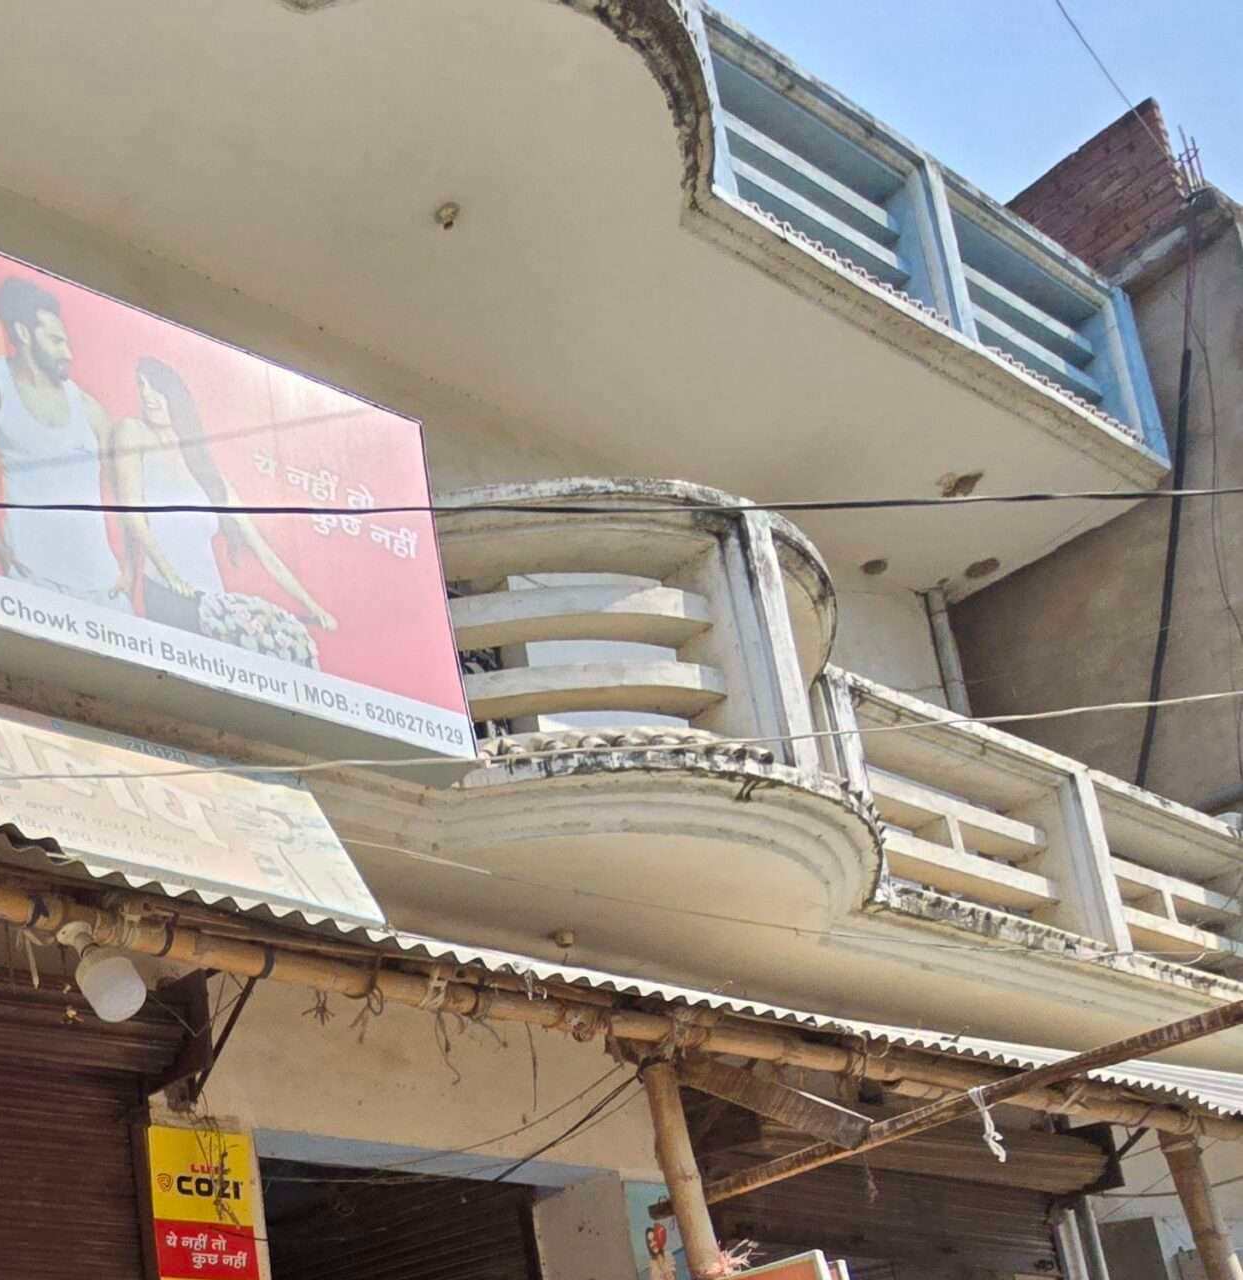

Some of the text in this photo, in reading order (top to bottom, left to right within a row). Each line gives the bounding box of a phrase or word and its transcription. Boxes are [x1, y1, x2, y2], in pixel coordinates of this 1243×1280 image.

[286, 470, 340, 501] नहीं
[370, 525, 419, 559] नहीं
[0, 596, 79, 634] Chowk
[85, 620, 154, 656] Simari
[161, 641, 287, 694] Bakhtiyarpur
[304, 684, 360, 716] MOB.:
[365, 702, 463, 746] 6206276129
[176, 1176, 241, 1200] COZI
[165, 1231, 227, 1250] ये नहीं तो
[192, 1252, 247, 1268] कुछ नहीं
